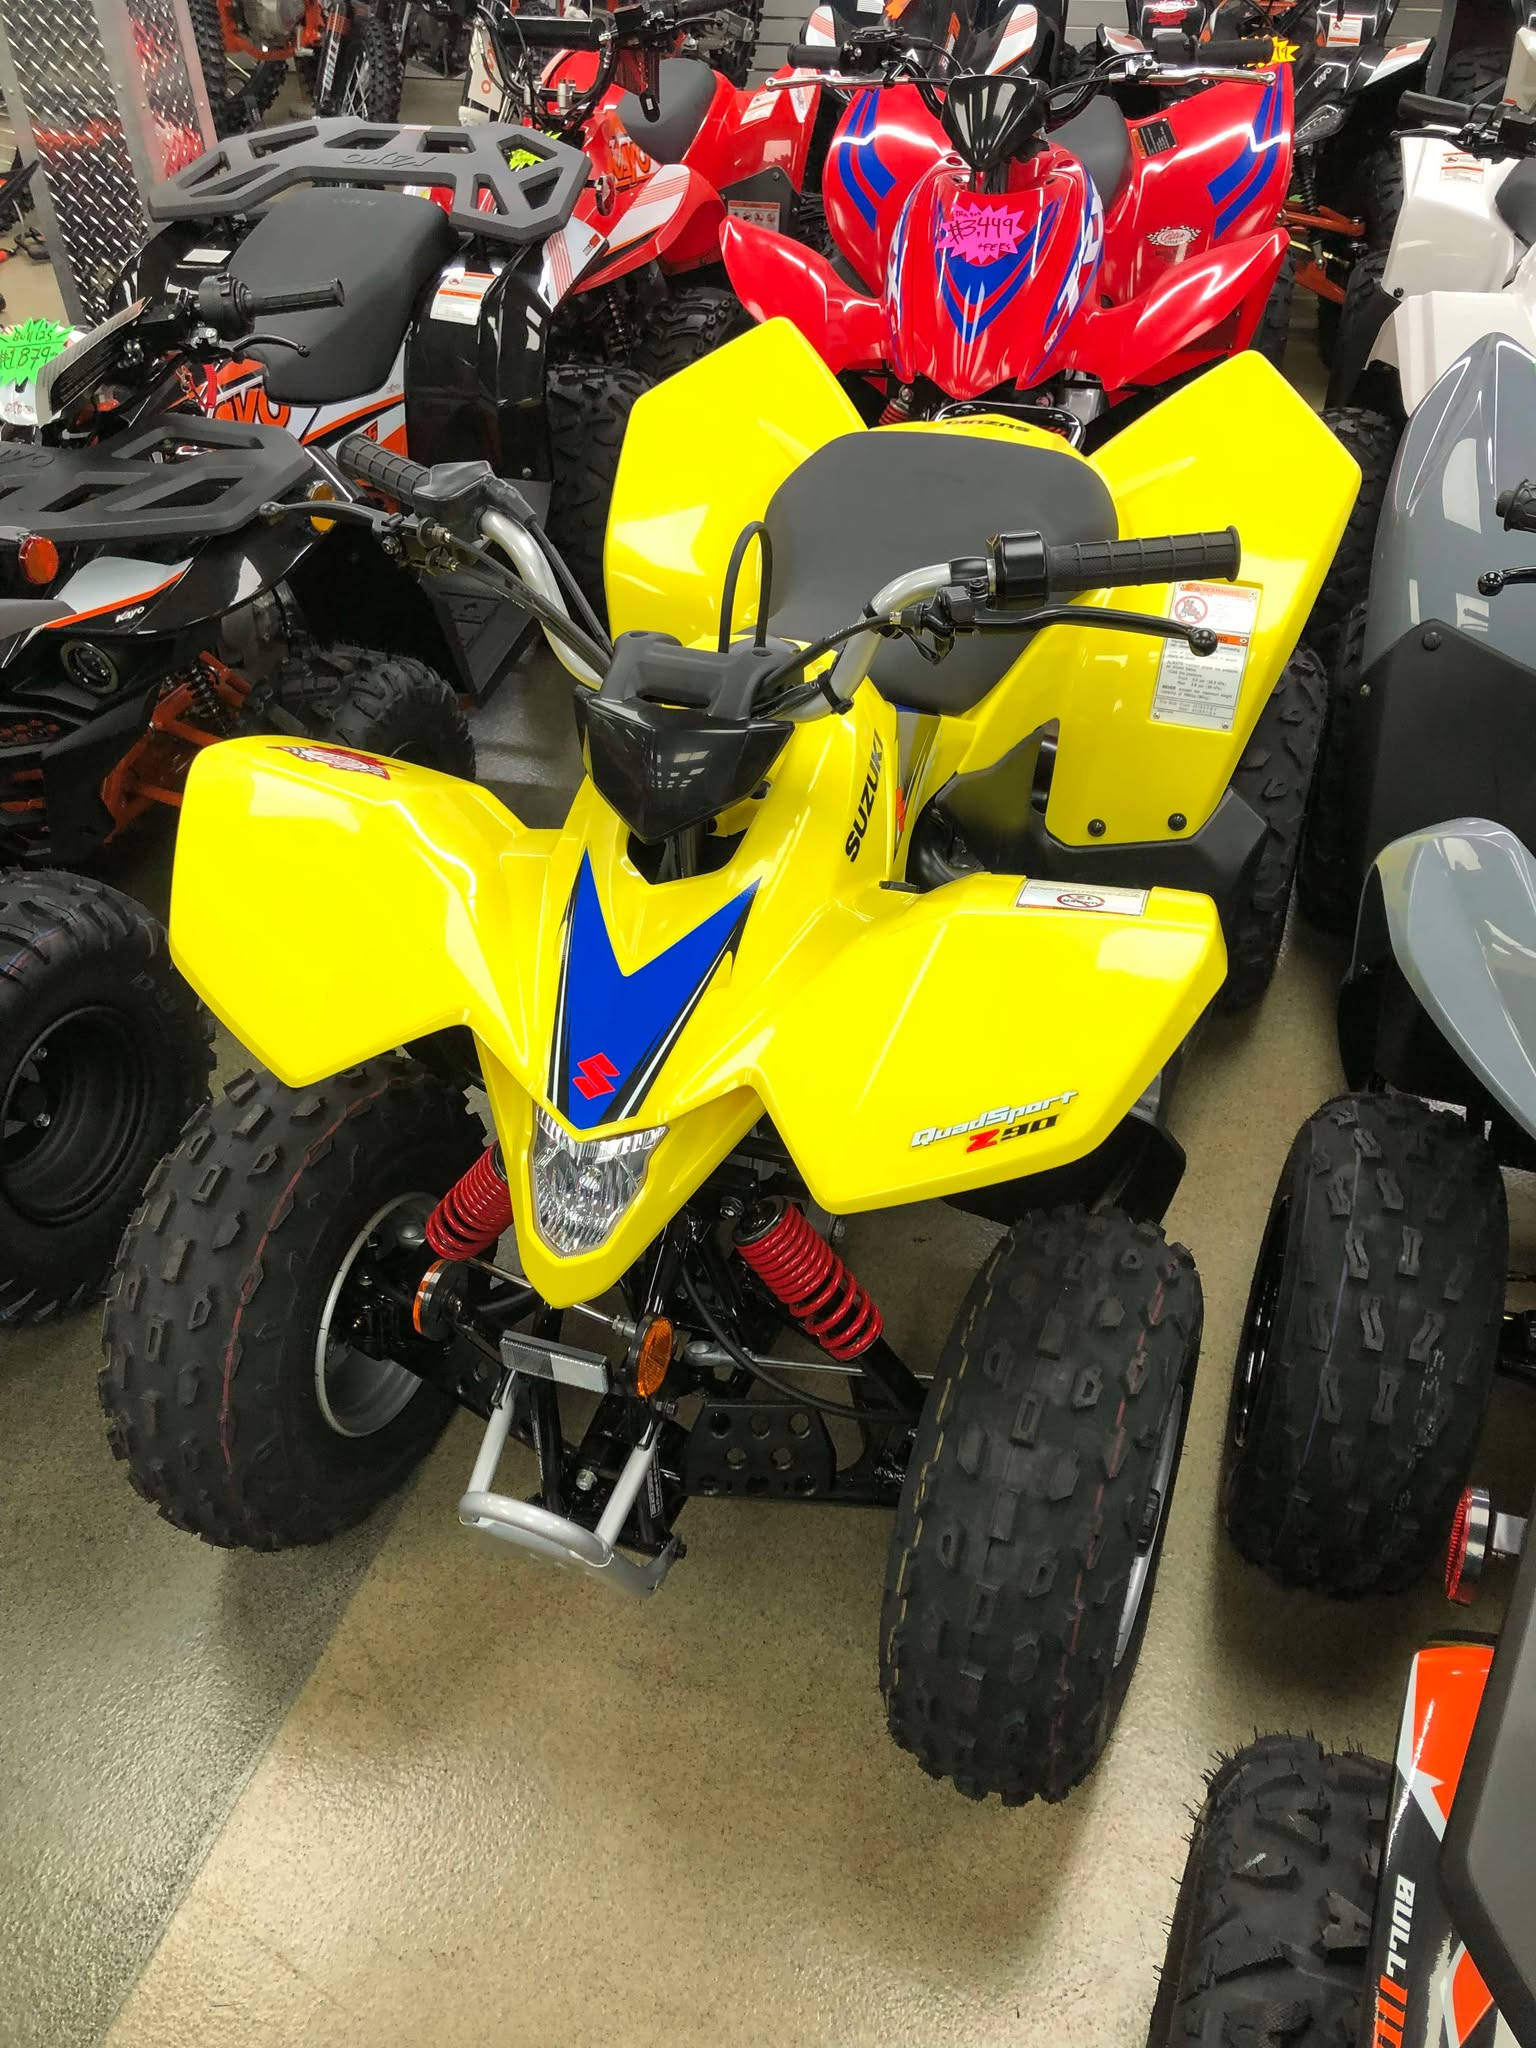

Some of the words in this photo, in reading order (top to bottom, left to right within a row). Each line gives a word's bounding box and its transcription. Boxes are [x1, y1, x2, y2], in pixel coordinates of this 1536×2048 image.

[845, 727, 884, 863] SUZUKI
[911, 1090, 1078, 1147] QuadSport
[1386, 1874, 1416, 1978] BULL
